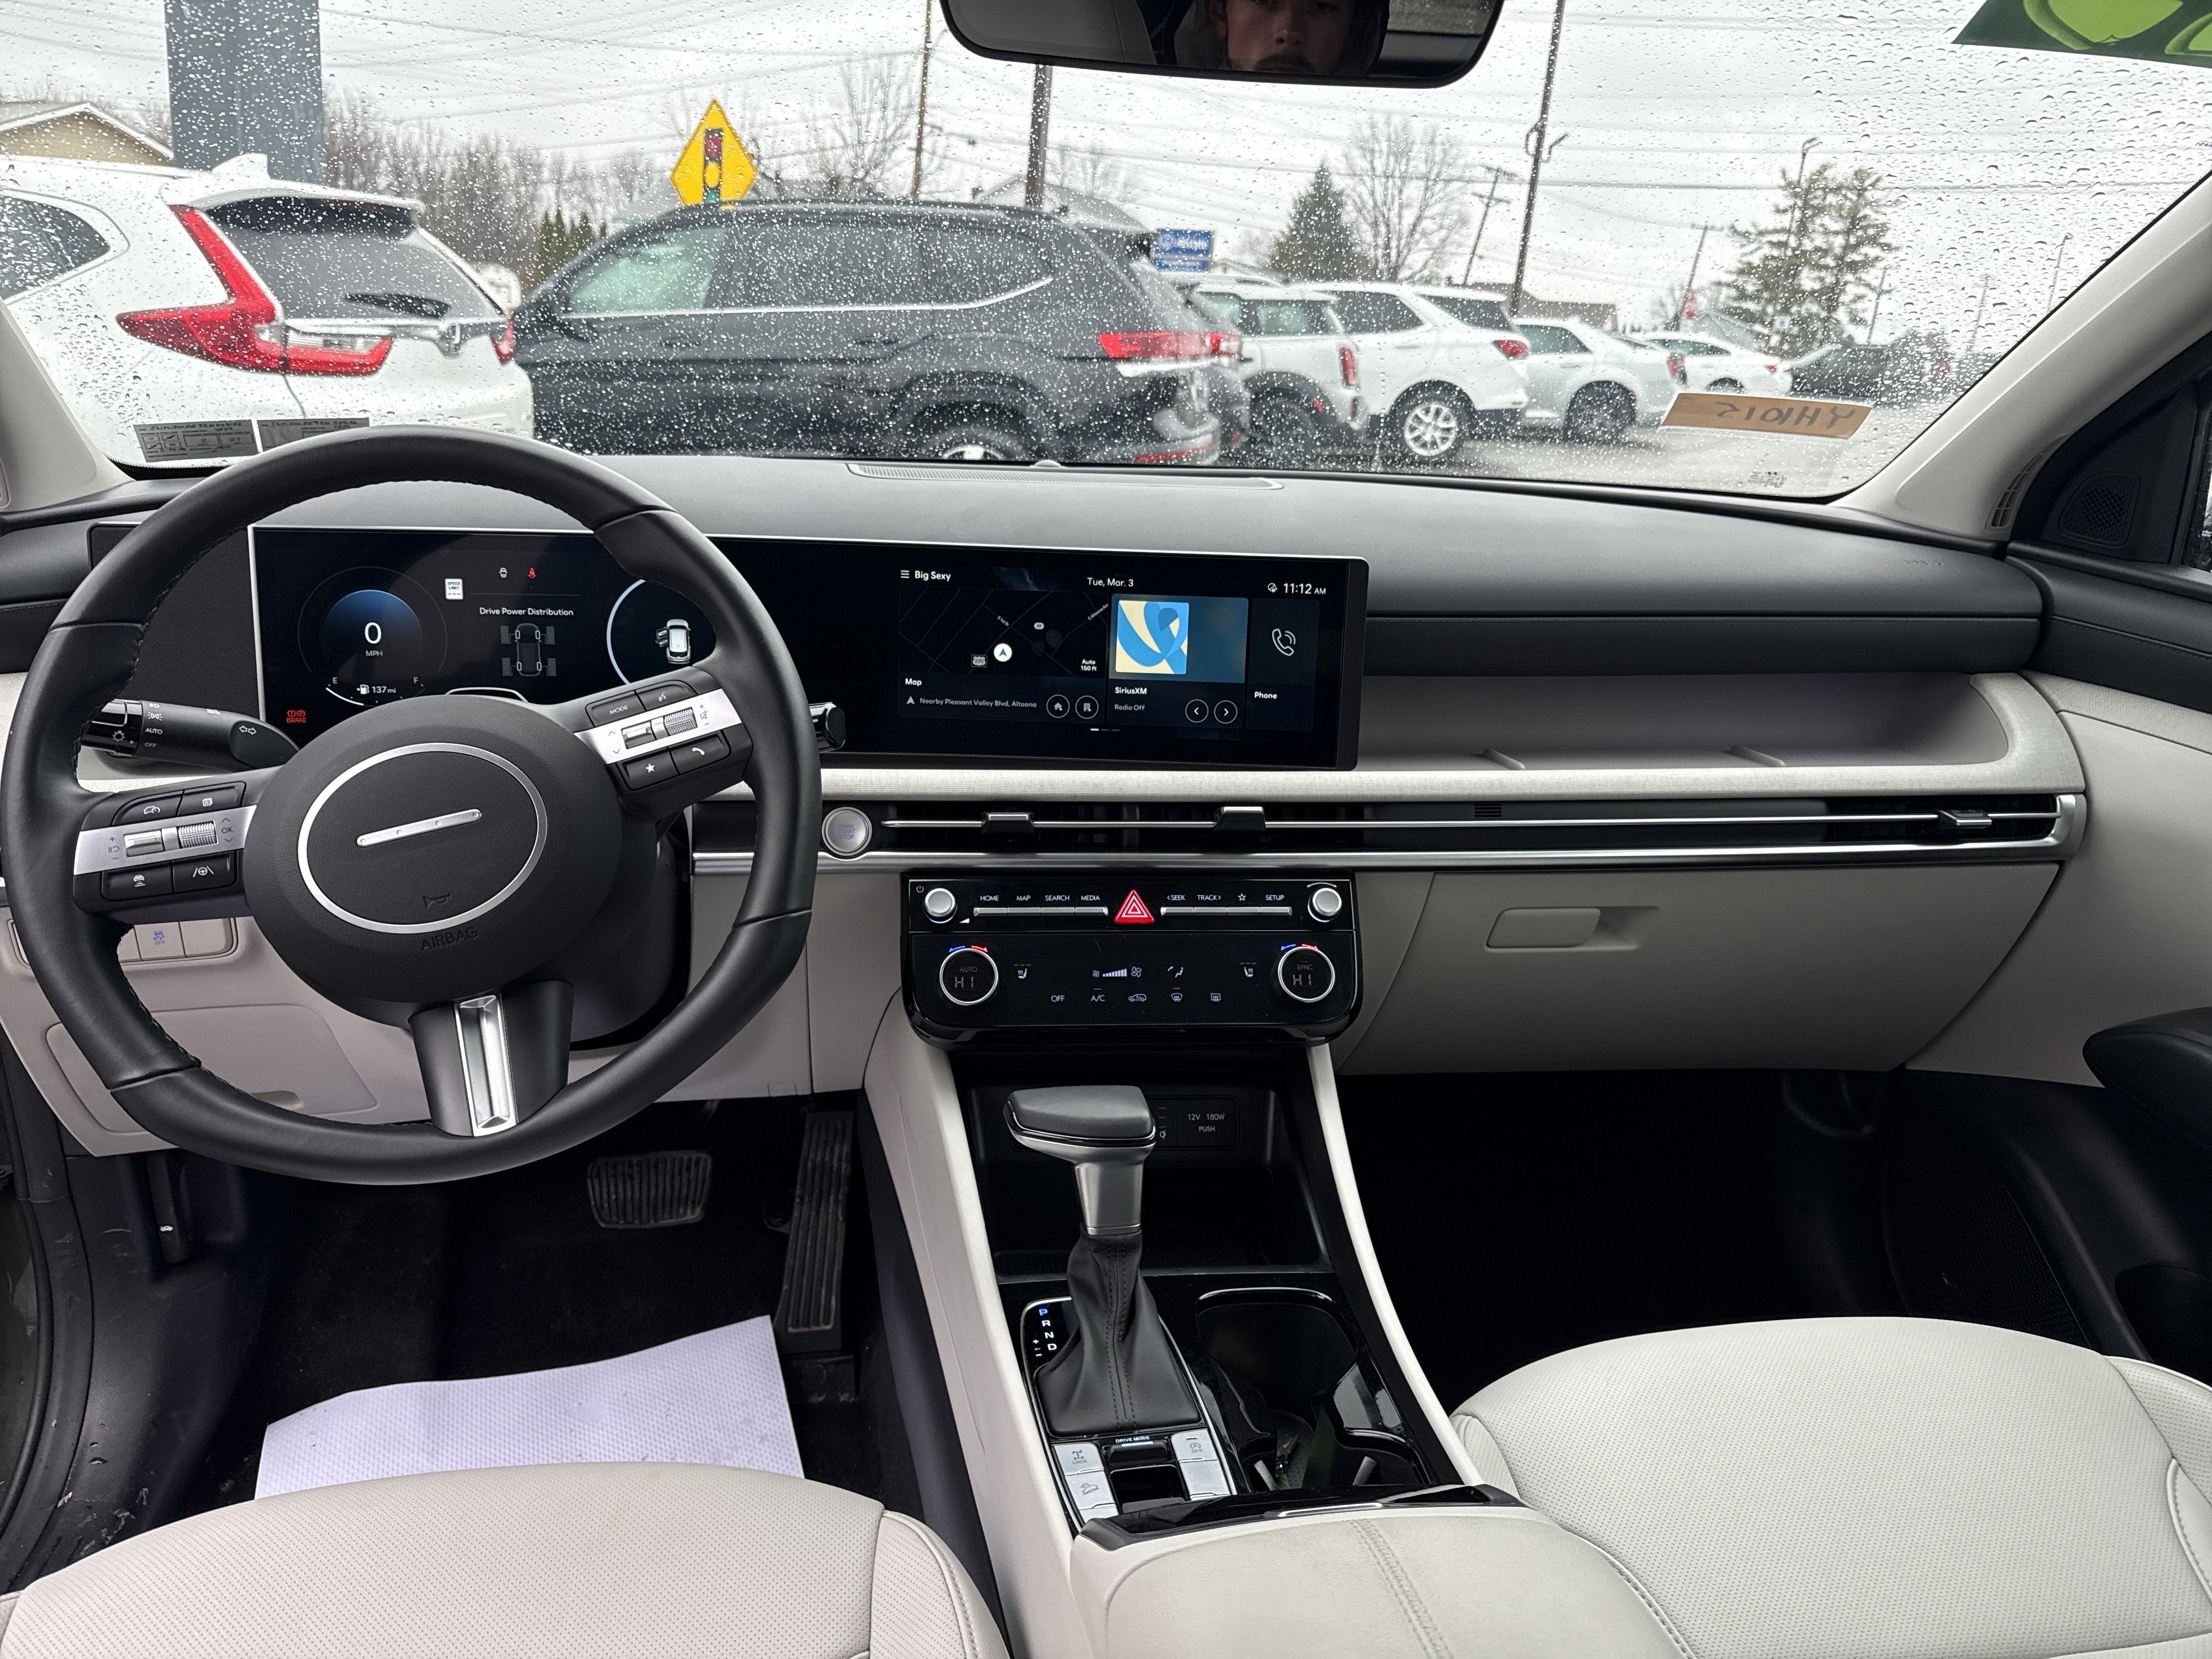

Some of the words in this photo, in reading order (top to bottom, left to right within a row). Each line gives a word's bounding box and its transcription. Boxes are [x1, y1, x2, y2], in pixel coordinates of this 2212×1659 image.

[915, 571, 928, 581] Big
[931, 571, 951, 582] Sexy
[1087, 577, 1105, 586] Tue,
[1108, 578, 1126, 586] Mar.
[1128, 579, 1134, 587] 3
[1283, 583, 1312, 594] 11:12
[365, 622, 381, 644] 0
[1255, 691, 1277, 699] Phone
[920, 698, 944, 706] Nearby
[974, 699, 994, 708] Valley
[610, 704, 629, 715] MODE
[422, 927, 478, 952] AIRBAG
